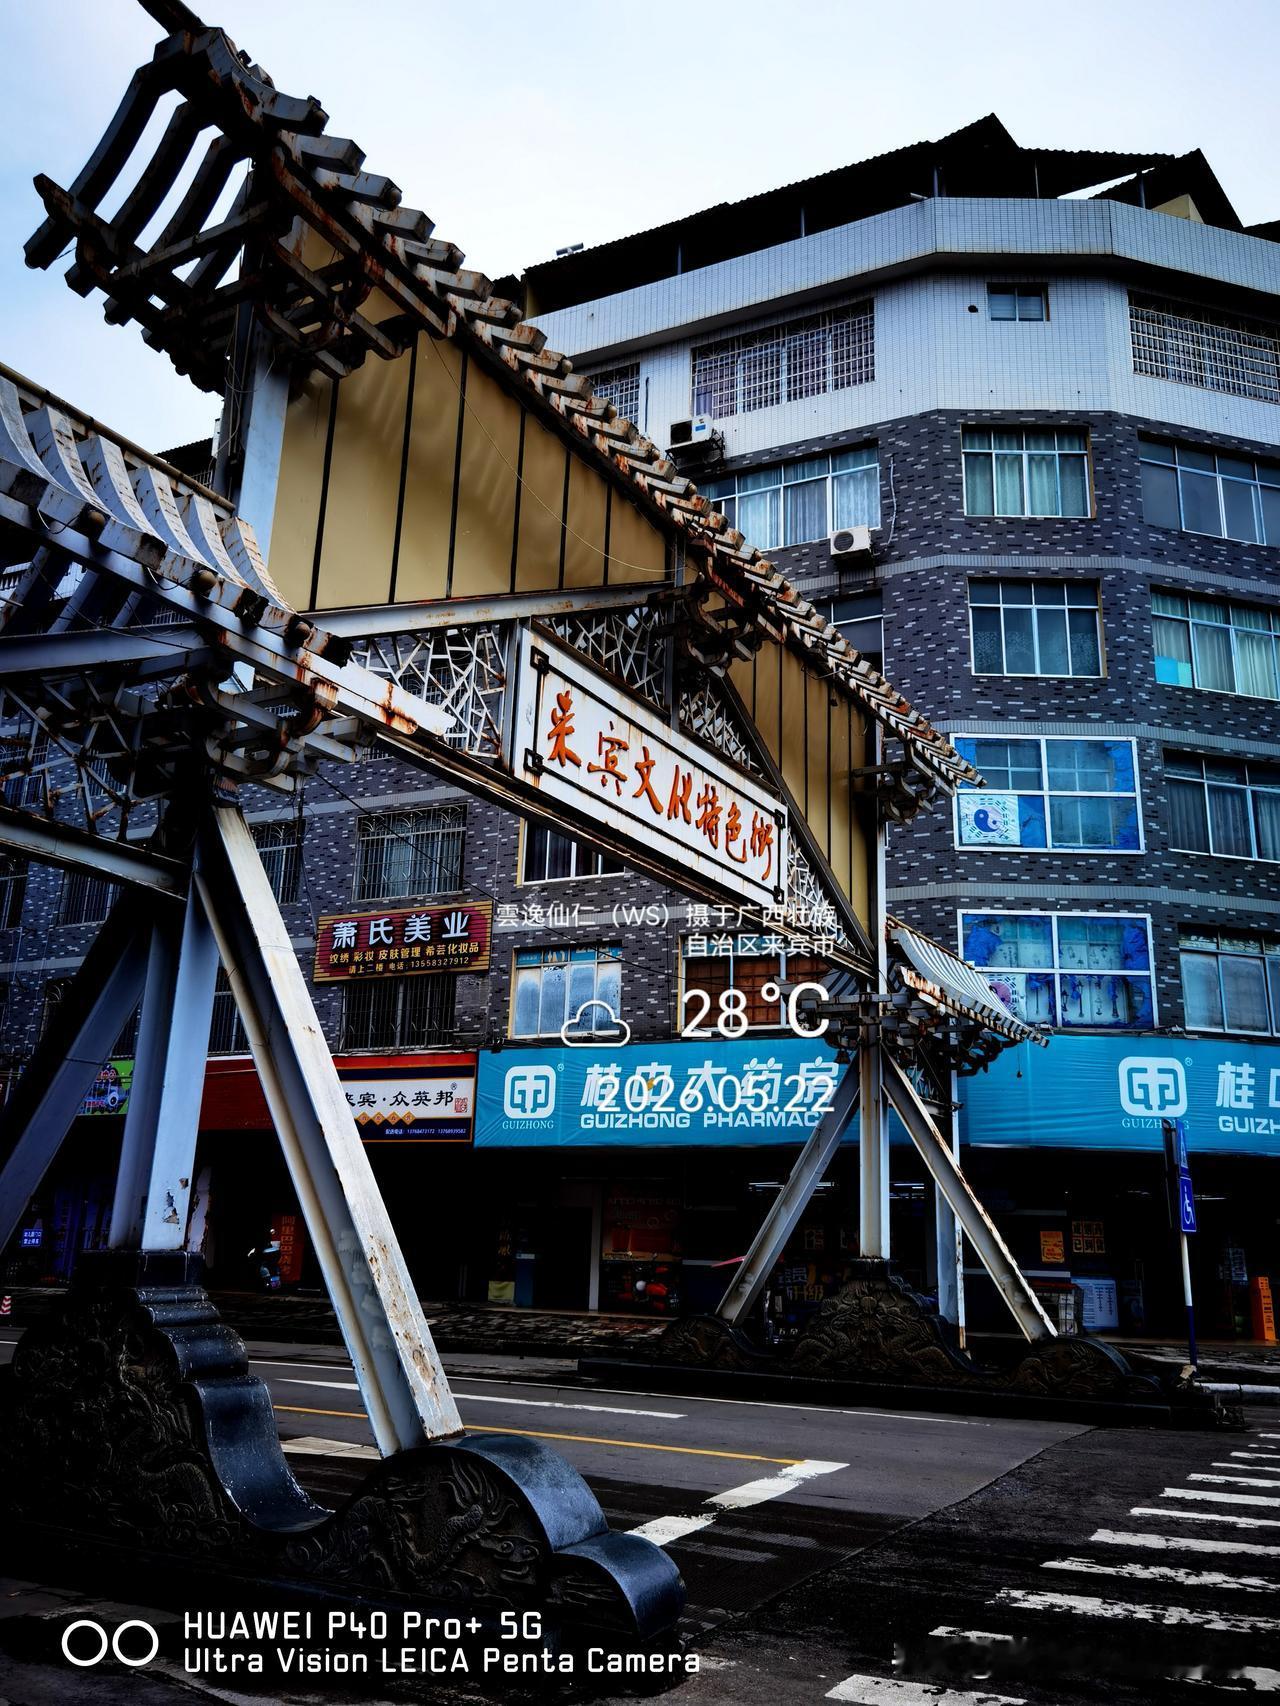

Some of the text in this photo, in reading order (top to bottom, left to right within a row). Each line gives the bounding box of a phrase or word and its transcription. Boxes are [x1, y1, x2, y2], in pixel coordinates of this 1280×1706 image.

[332, 911, 470, 949] 萧氏美业
[353, 951, 374, 962] 彩妆
[378, 947, 421, 961] 皮肤管理
[580, 1056, 839, 1107] 桂中大药房
[502, 1120, 554, 1129] GUIZHONG
[580, 1111, 824, 1128] GUIZHONG PHARMAC
[1121, 1117, 1190, 1130] GUIZHNG
